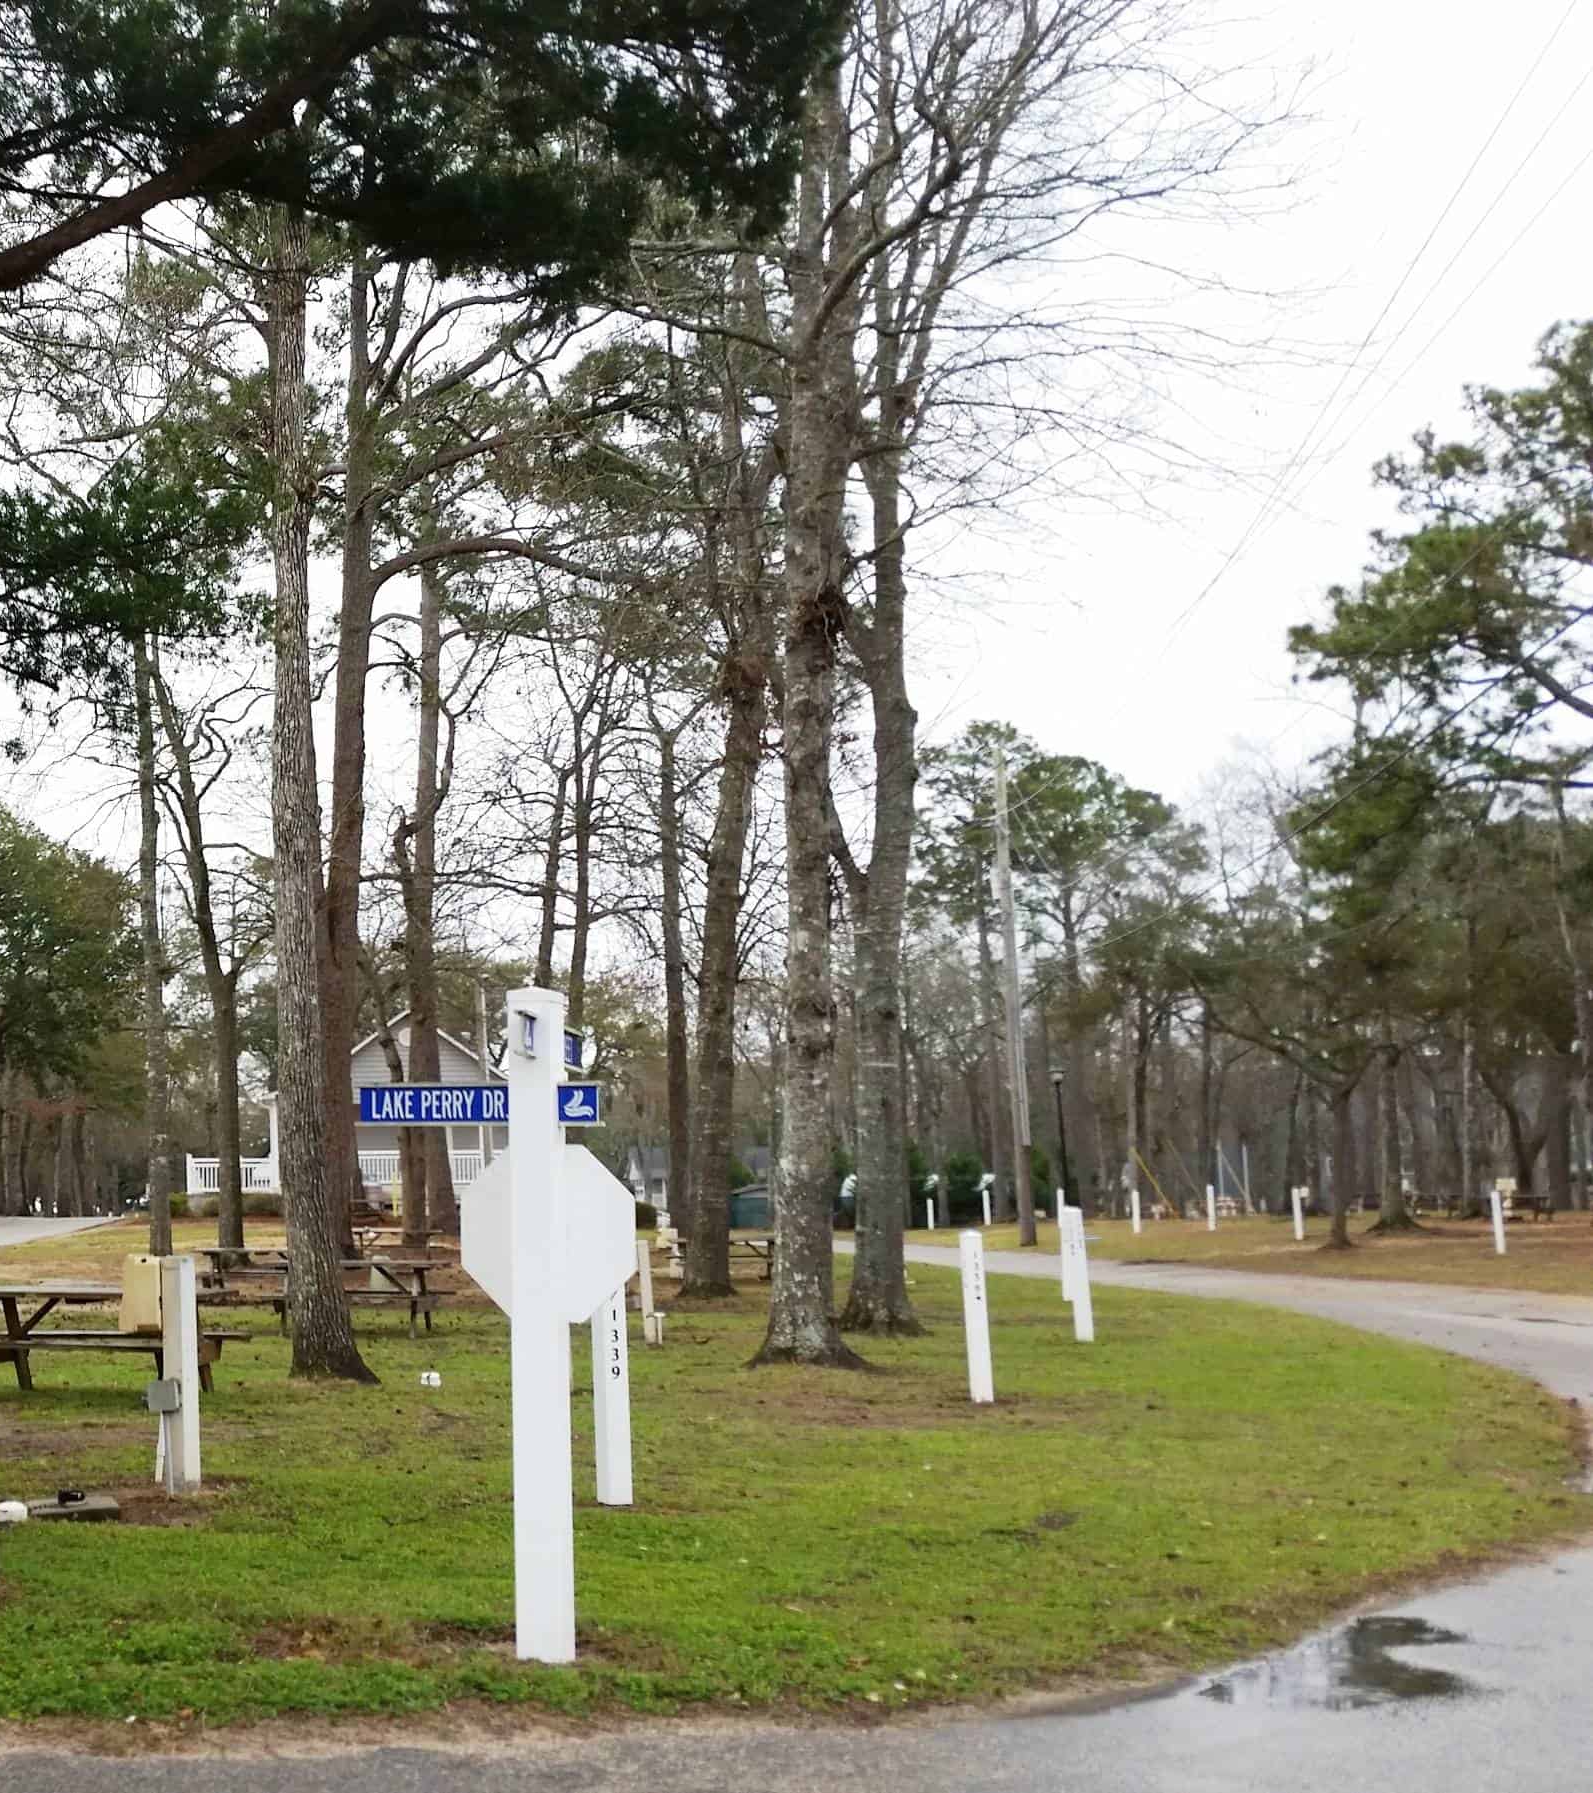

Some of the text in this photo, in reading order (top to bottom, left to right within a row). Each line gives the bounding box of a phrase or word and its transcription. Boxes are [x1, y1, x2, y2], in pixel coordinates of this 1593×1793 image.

[371, 1089, 414, 1120] LAKE
[420, 1088, 475, 1120] PERRY
[610, 1308, 622, 1380] 1339
